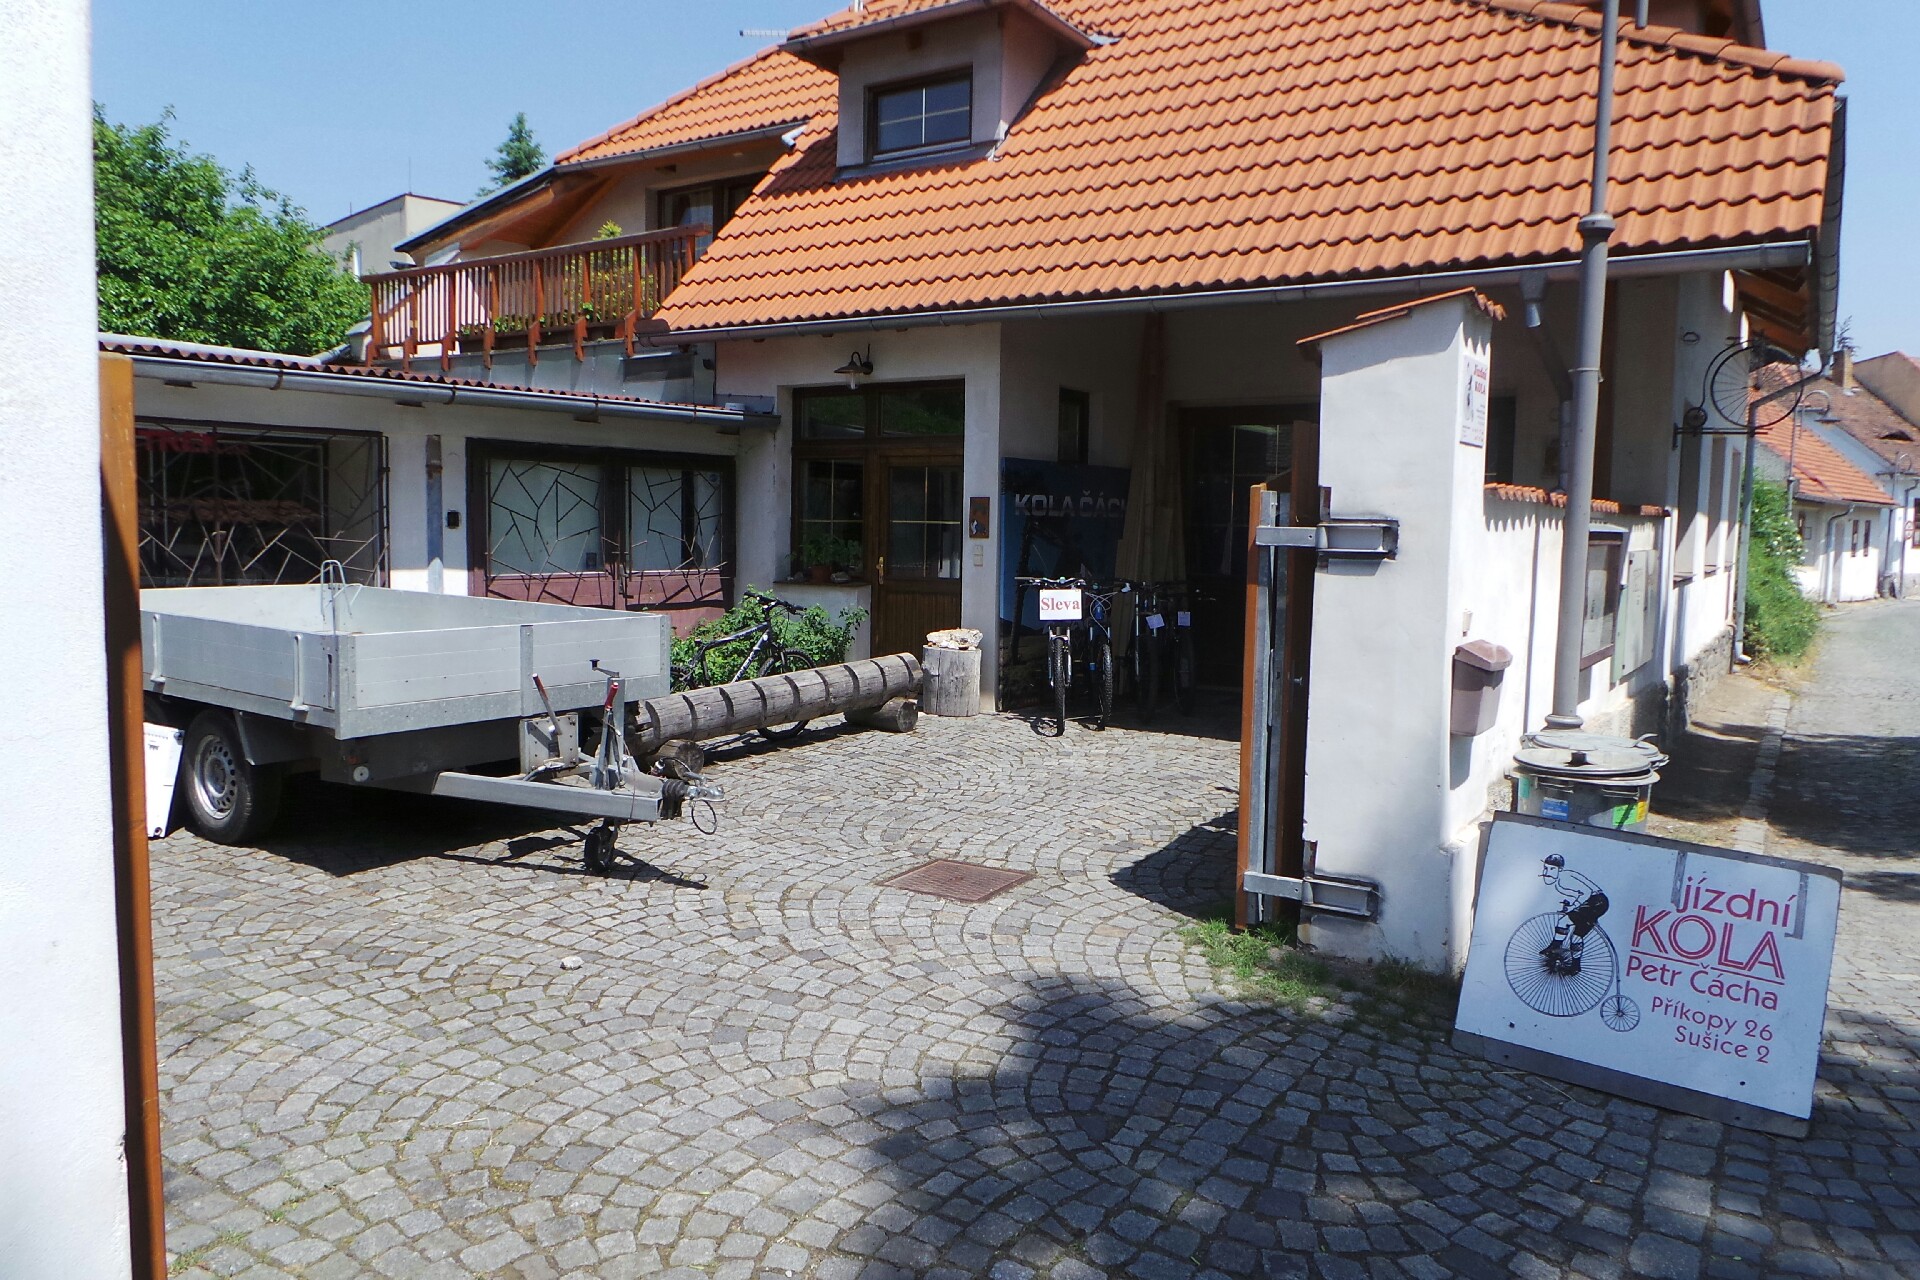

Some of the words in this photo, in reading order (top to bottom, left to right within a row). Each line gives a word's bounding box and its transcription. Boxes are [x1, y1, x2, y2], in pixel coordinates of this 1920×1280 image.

[1015, 493, 1075, 517] KOLA
[1041, 597, 1080, 611] Sleva
[1676, 876, 1797, 928] jízdní
[1631, 905, 1785, 980] KOLA
[1626, 955, 1682, 988] Petr
[1690, 962, 1778, 1011] Čácha
[1651, 996, 1738, 1035] Příkopy
[1744, 1019, 1773, 1042] 26
[1674, 1025, 1749, 1058] Sušice
[1755, 1045, 1770, 1064] 2
